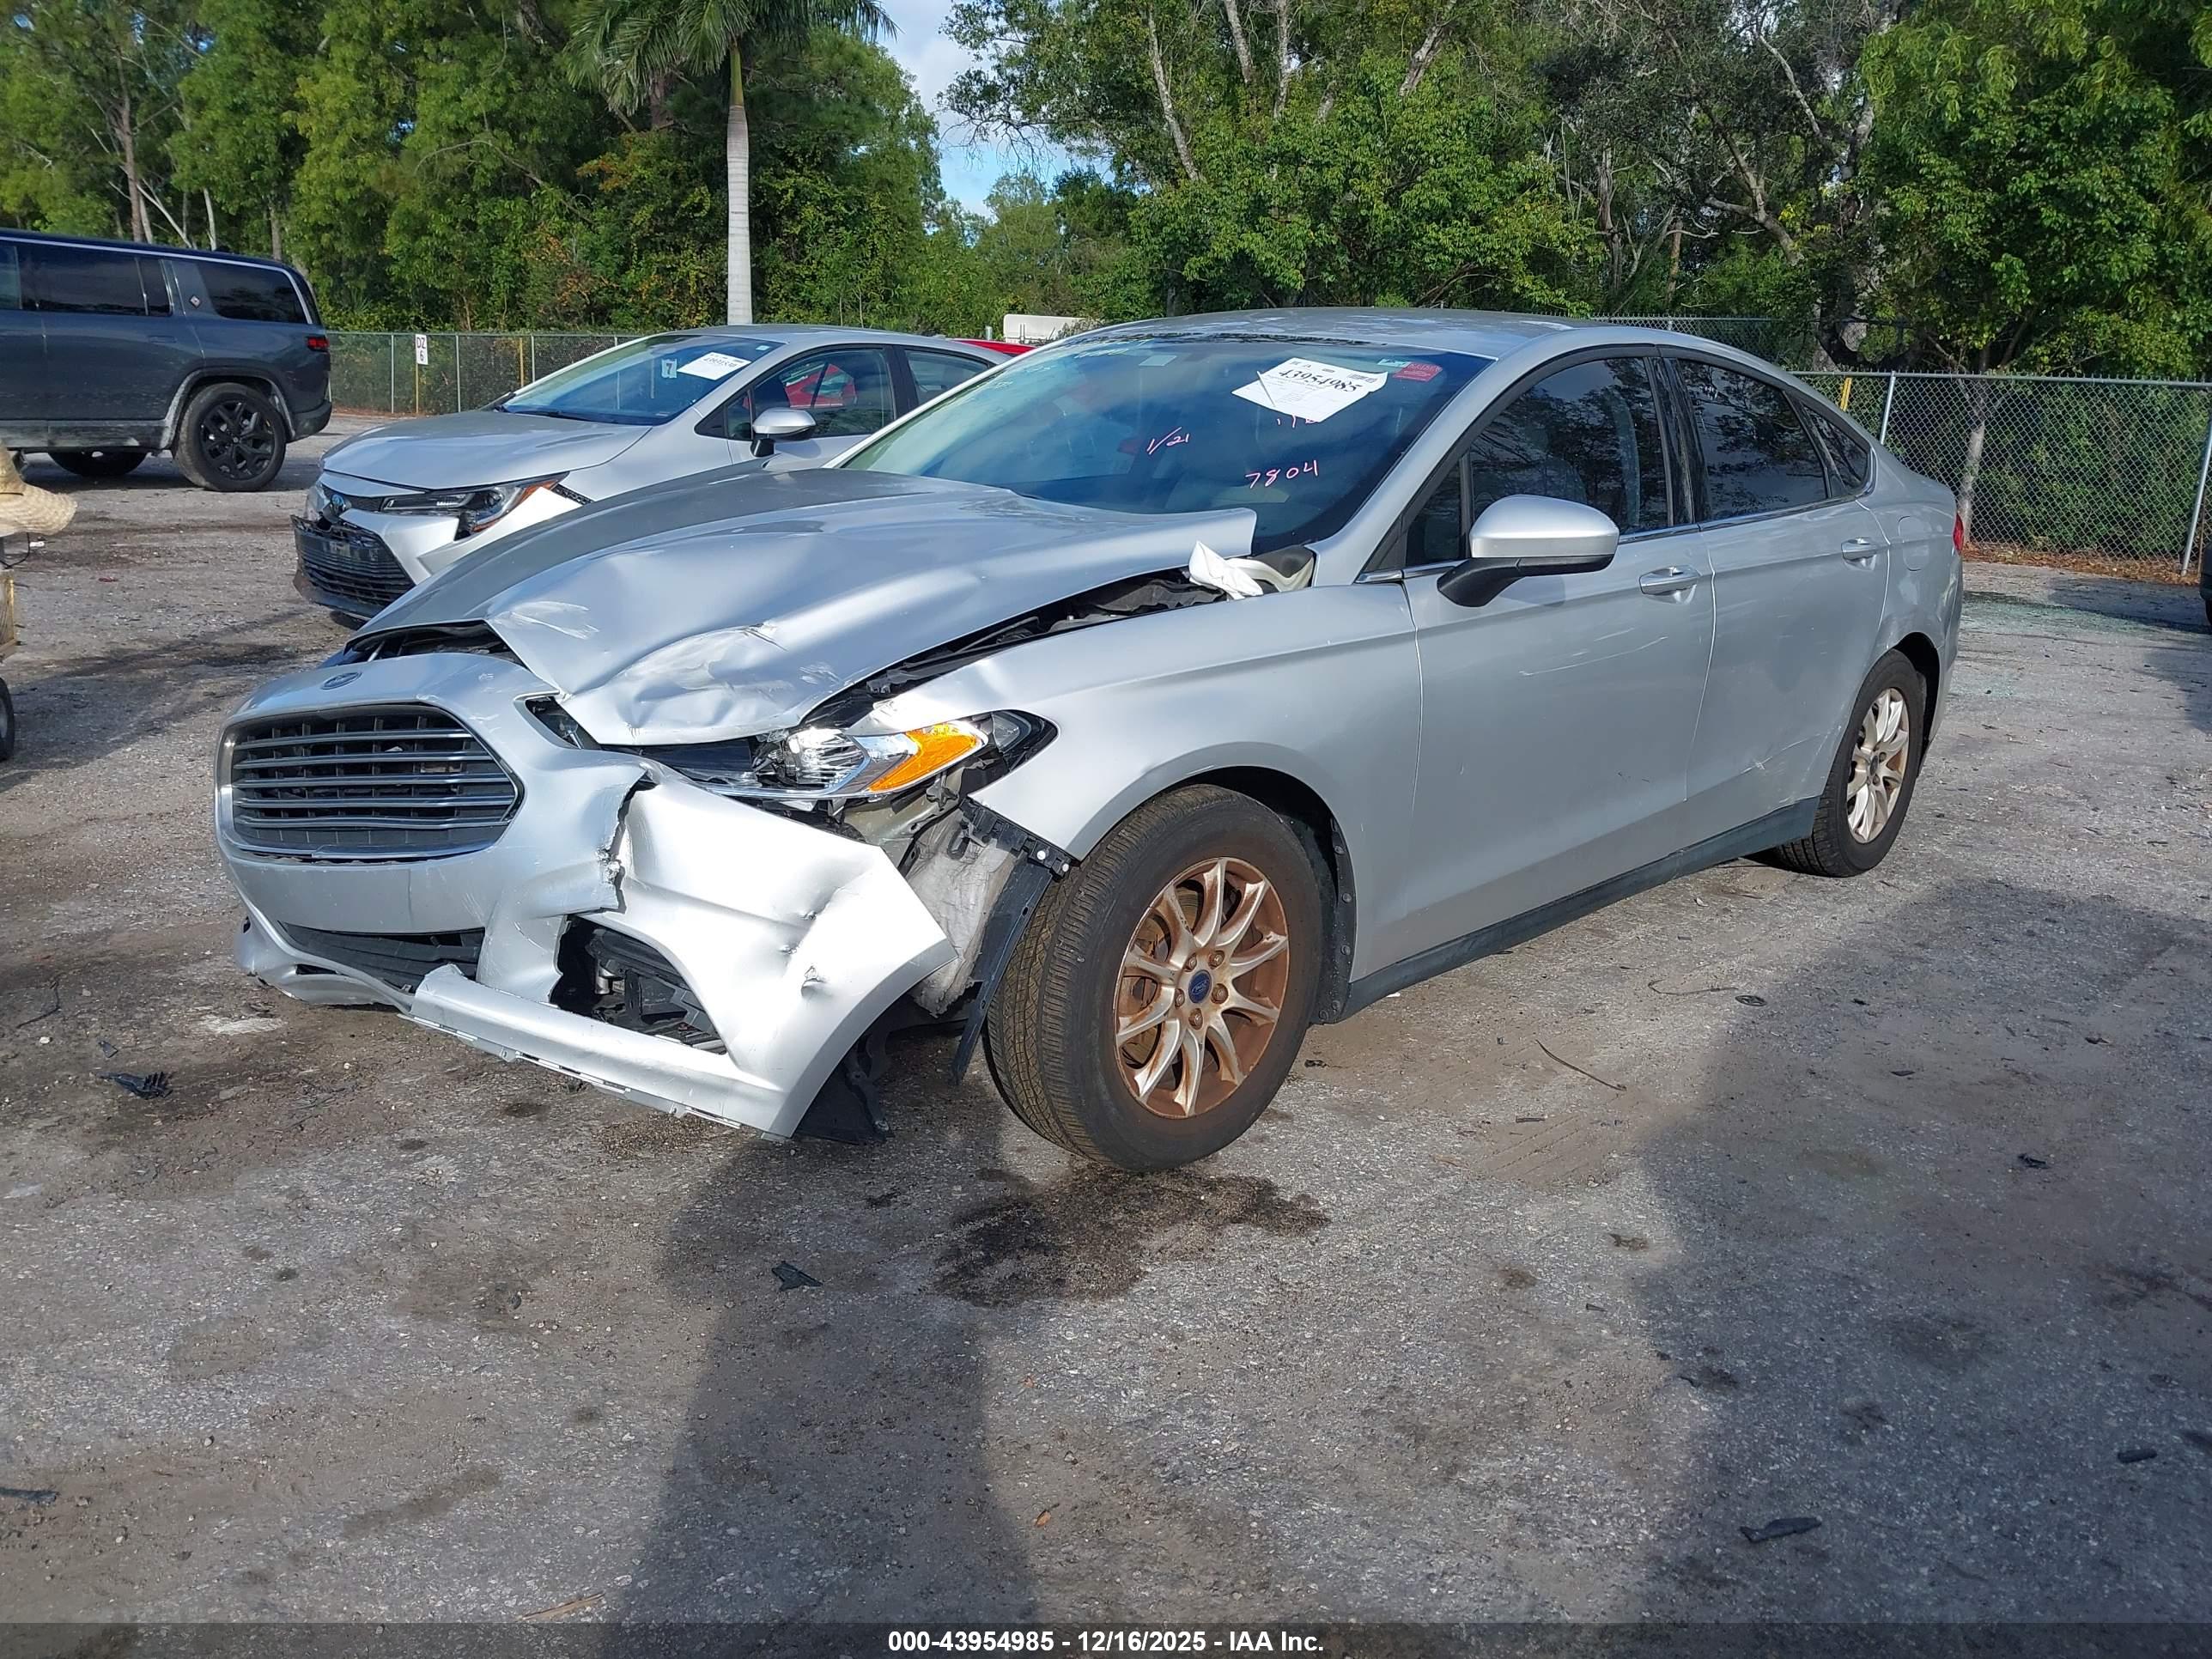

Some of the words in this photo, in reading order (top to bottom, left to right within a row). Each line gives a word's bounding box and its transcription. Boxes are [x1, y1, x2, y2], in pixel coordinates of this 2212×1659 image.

[420, 350, 424, 362] 6
[665, 362, 673, 375] 7
[1279, 368, 1364, 392] 43954985
[1245, 459, 1318, 489] 7804
